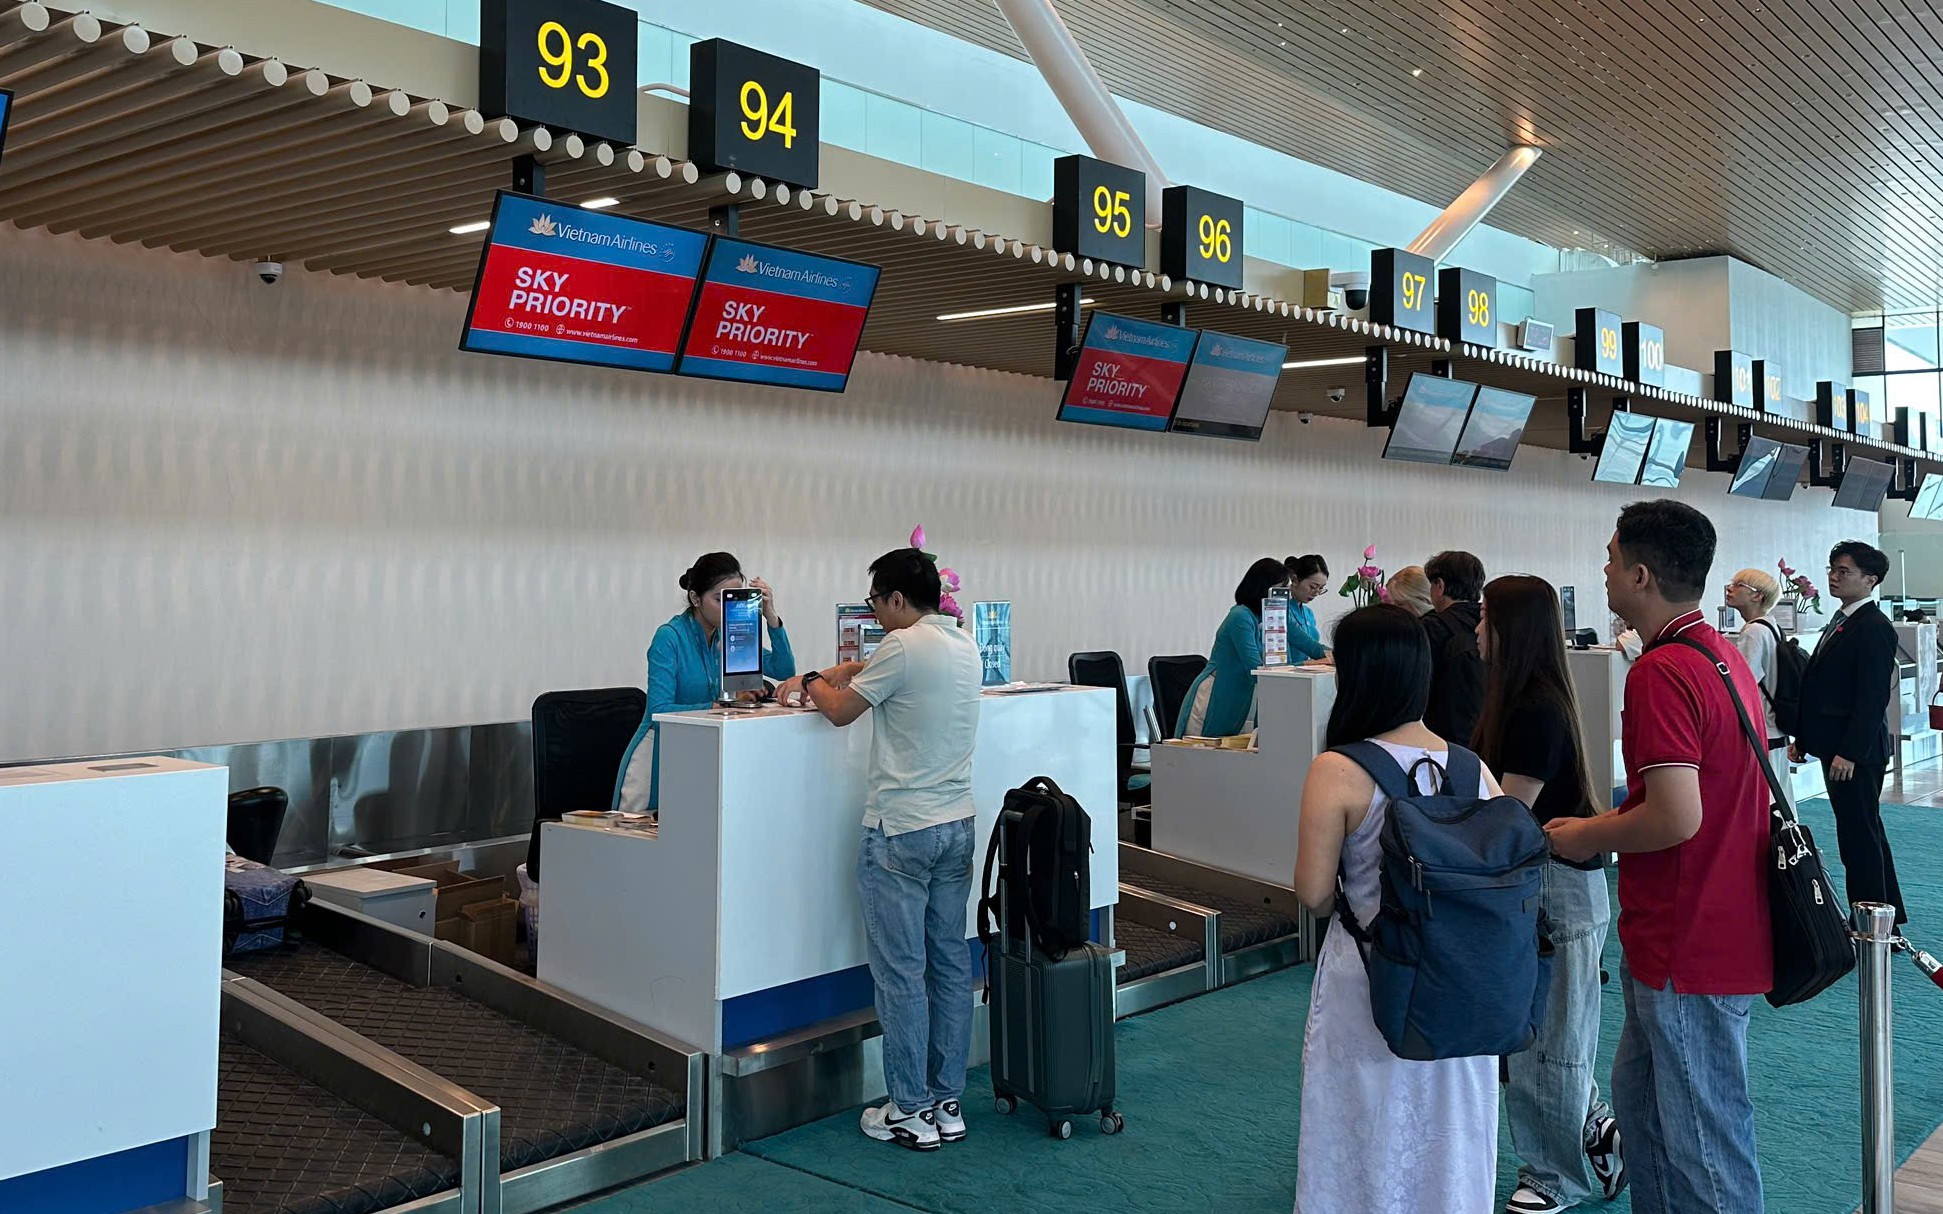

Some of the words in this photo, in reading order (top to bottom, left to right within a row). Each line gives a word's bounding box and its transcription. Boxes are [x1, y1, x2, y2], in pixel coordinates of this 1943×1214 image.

[537, 20, 610, 99] 93
[739, 80, 797, 149] 94
[1093, 184, 1132, 238] 95
[1198, 213, 1232, 264] 96
[515, 266, 569, 293] SKY
[1401, 270, 1427, 311] 97
[508, 289, 627, 324] PRIORITY
[722, 300, 766, 323] SKY
[1467, 288, 1490, 327] 98
[515, 320, 532, 330] 1900
[533, 323, 549, 332] 1100
[566, 328, 638, 344] www.vietnamairlines.com
[715, 321, 810, 349] PRIORITY
[1601, 327, 1618, 360] 99
[1092, 361, 1121, 378] SKY
[1640, 339, 1662, 370] 100
[1086, 377, 1148, 398] PRIORITY
[1735, 366, 1752, 393] 101
